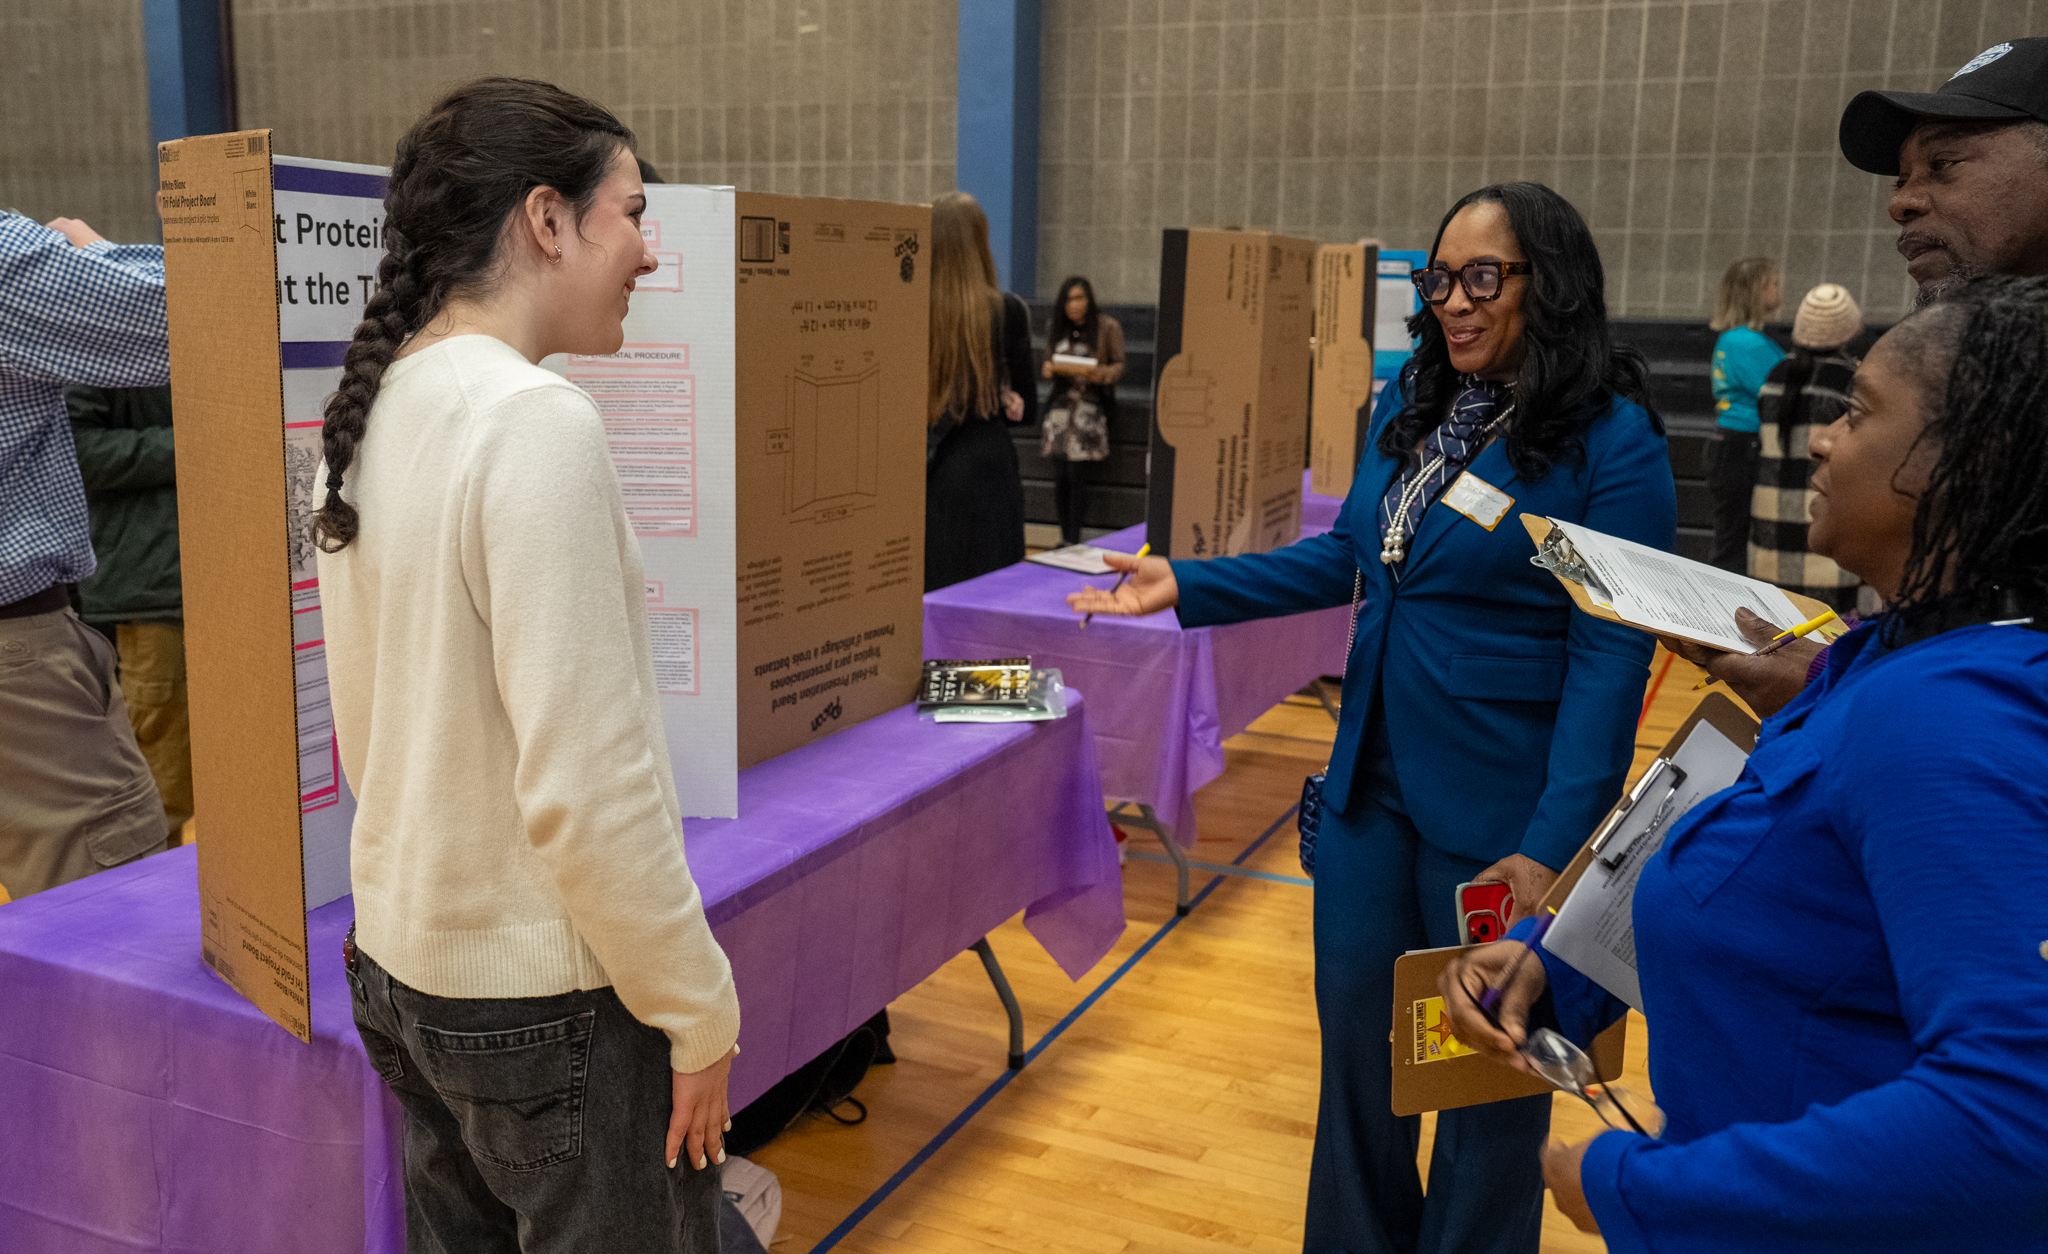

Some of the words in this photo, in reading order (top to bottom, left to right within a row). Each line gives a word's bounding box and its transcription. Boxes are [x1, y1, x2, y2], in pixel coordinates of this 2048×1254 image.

[170, 196, 180, 208] Fold
[181, 194, 199, 210] Project
[200, 193, 216, 206] Board
[278, 275, 298, 304] t
[306, 272, 349, 304] the
[772, 692, 797, 713] Board
[242, 939, 259, 960] Board
[260, 952, 280, 975] Project
[281, 968, 294, 985] Fold
[295, 979, 303, 992] Tri
[1416, 1041, 1424, 1061] WILLIE
